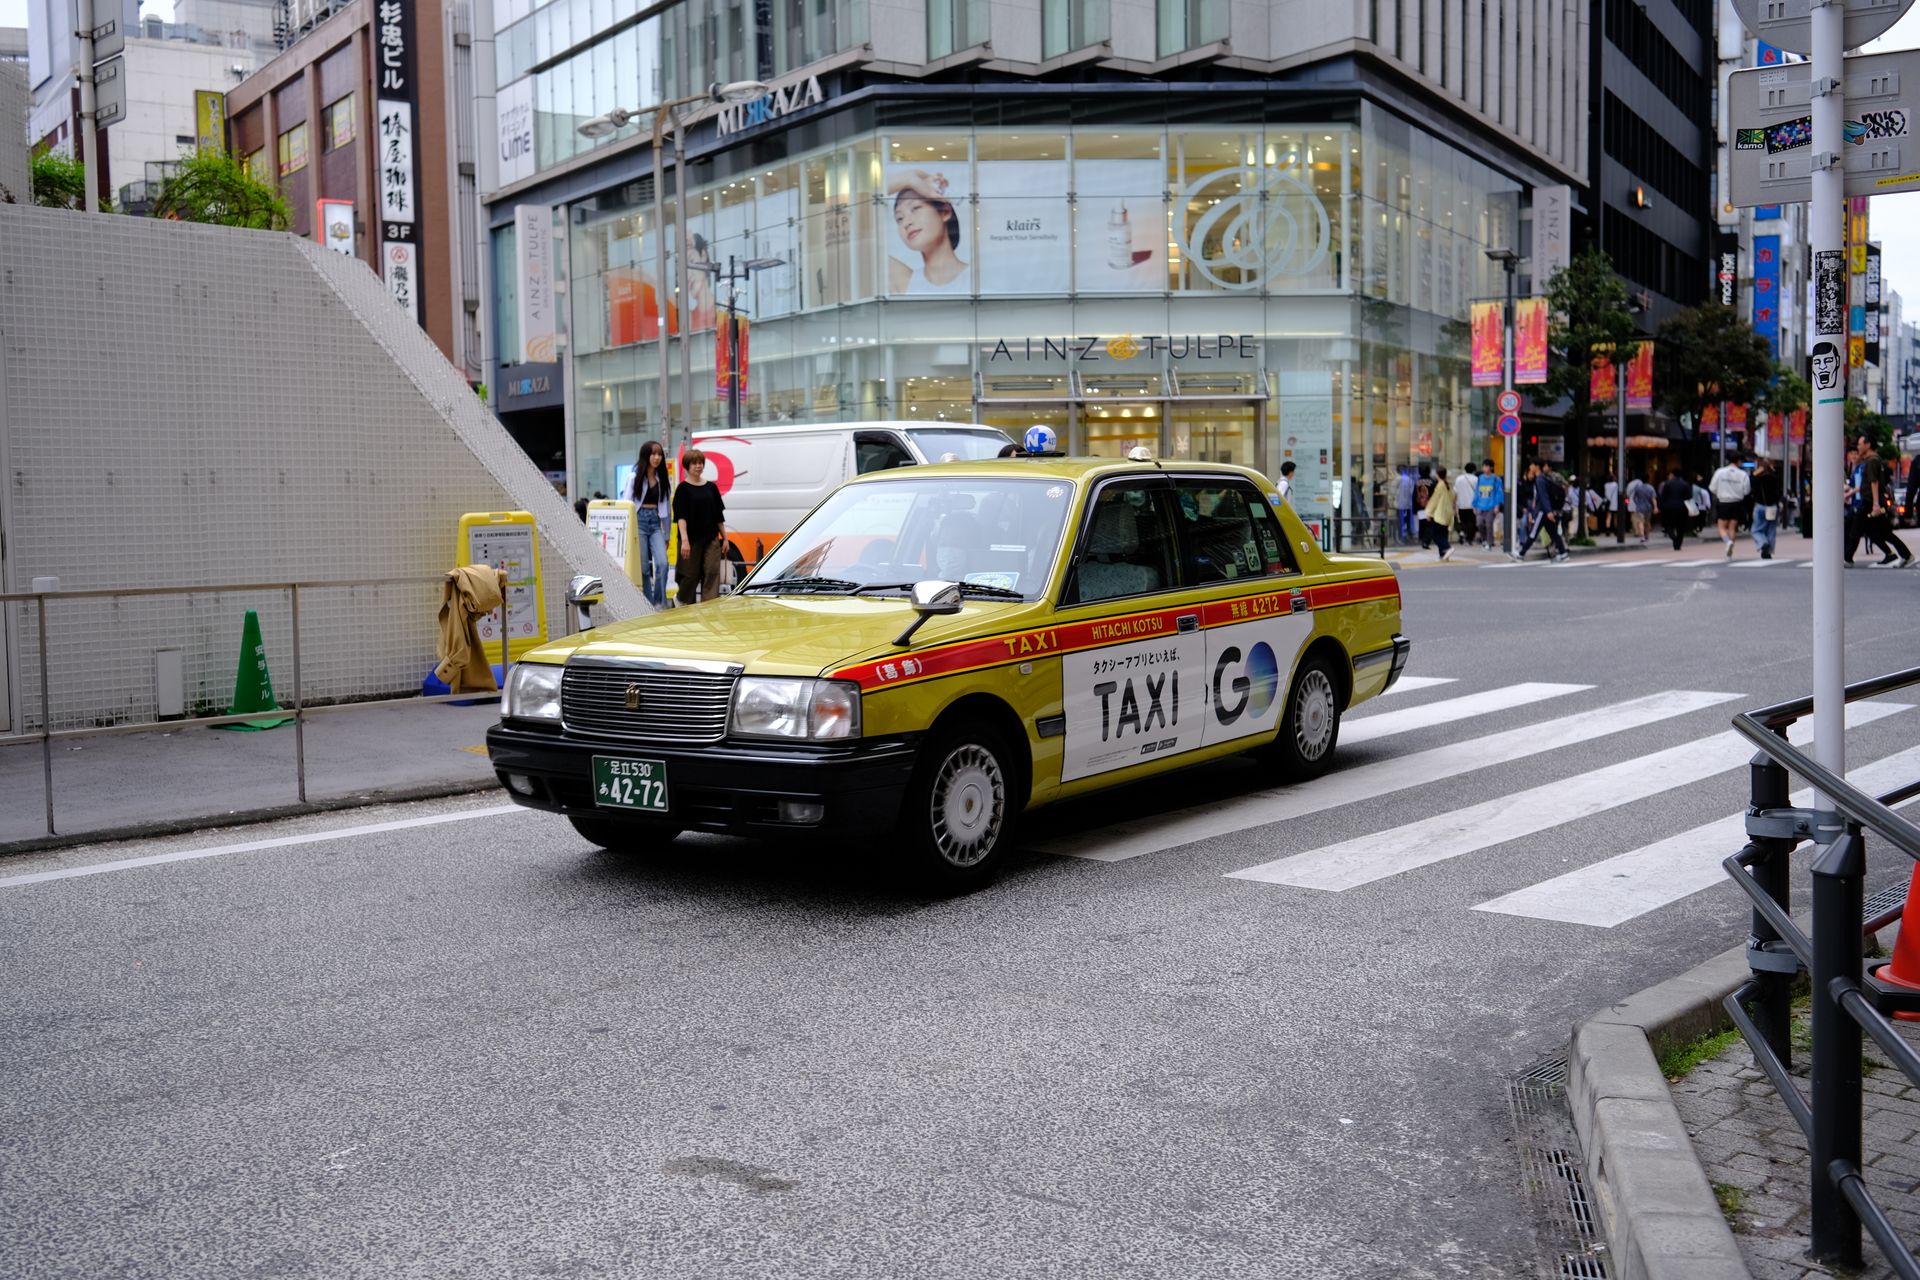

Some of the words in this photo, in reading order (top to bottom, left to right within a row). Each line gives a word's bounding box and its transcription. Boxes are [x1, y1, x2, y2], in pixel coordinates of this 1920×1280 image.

[380, 1, 404, 90] 杉忠ビル
[501, 131, 530, 162] LIME
[382, 112, 409, 212] 椿屋珈琲
[388, 224, 411, 239] 3F
[528, 215, 539, 259] TULPE
[528, 277, 542, 320] AINZ
[991, 337, 1100, 361] AINZ
[1142, 335, 1255, 360] TULPE
[1502, 396, 1516, 408] 30
[1231, 601, 1248, 618] 無線
[1252, 597, 1279, 615] 4272
[1091, 620, 1131, 640] HITACHI
[1133, 617, 1163, 633] KOTSU
[1004, 631, 1057, 656] TAXI
[1093, 647, 1180, 674] タクシーアプリといえば、
[1094, 670, 1178, 742] TAXI
[1213, 641, 1278, 726] GO
[599, 782, 609, 796] あ
[610, 777, 665, 808] 42-72
